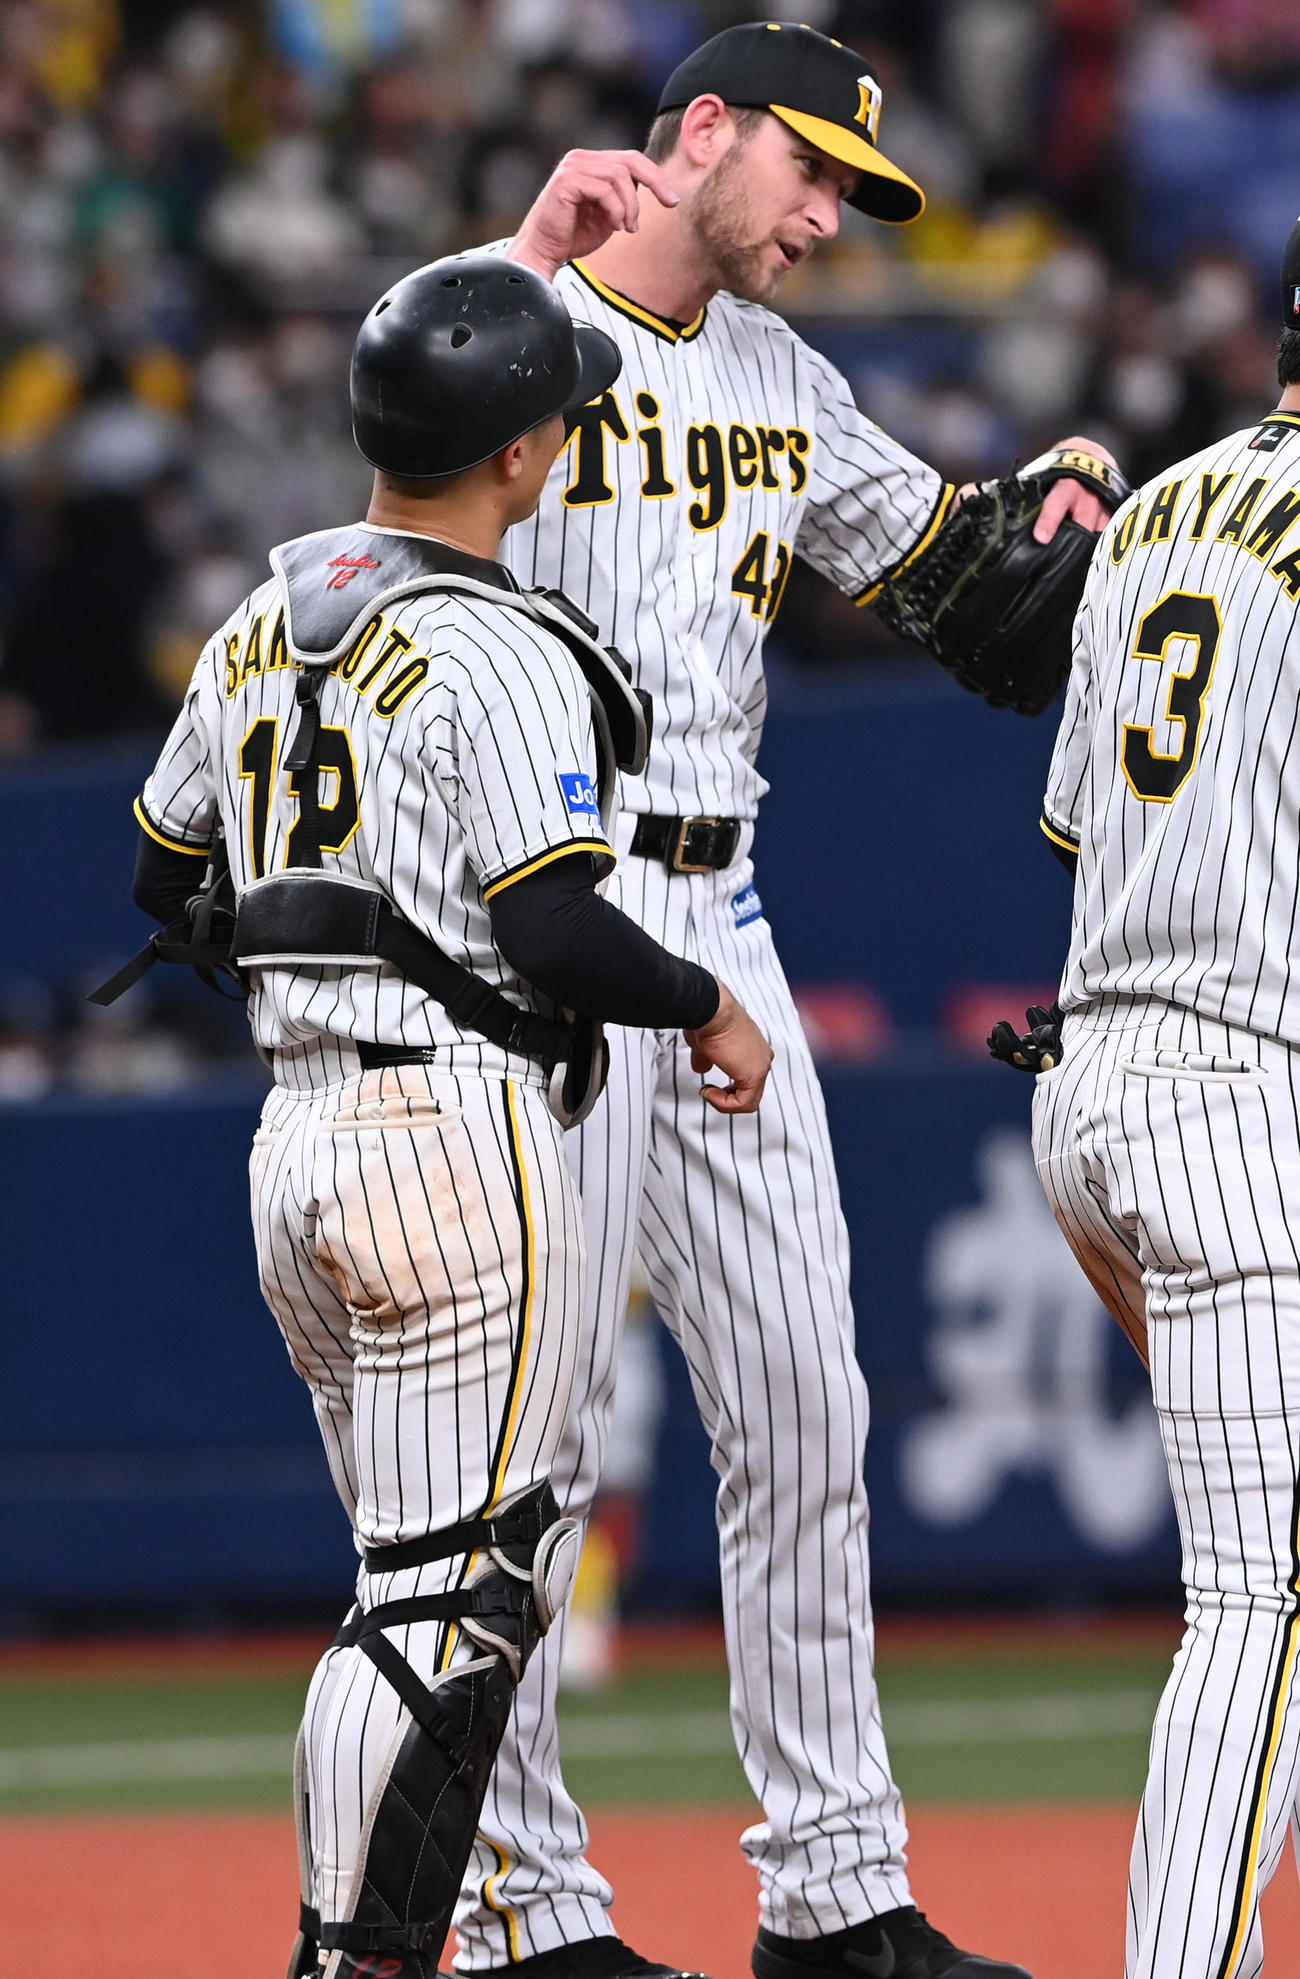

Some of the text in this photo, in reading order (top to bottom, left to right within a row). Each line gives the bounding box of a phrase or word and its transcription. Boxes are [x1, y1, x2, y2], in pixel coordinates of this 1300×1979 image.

[556, 388, 812, 534] Tigers
[225, 602, 431, 720] SAKOTO
[1122, 588, 1223, 804] 3
